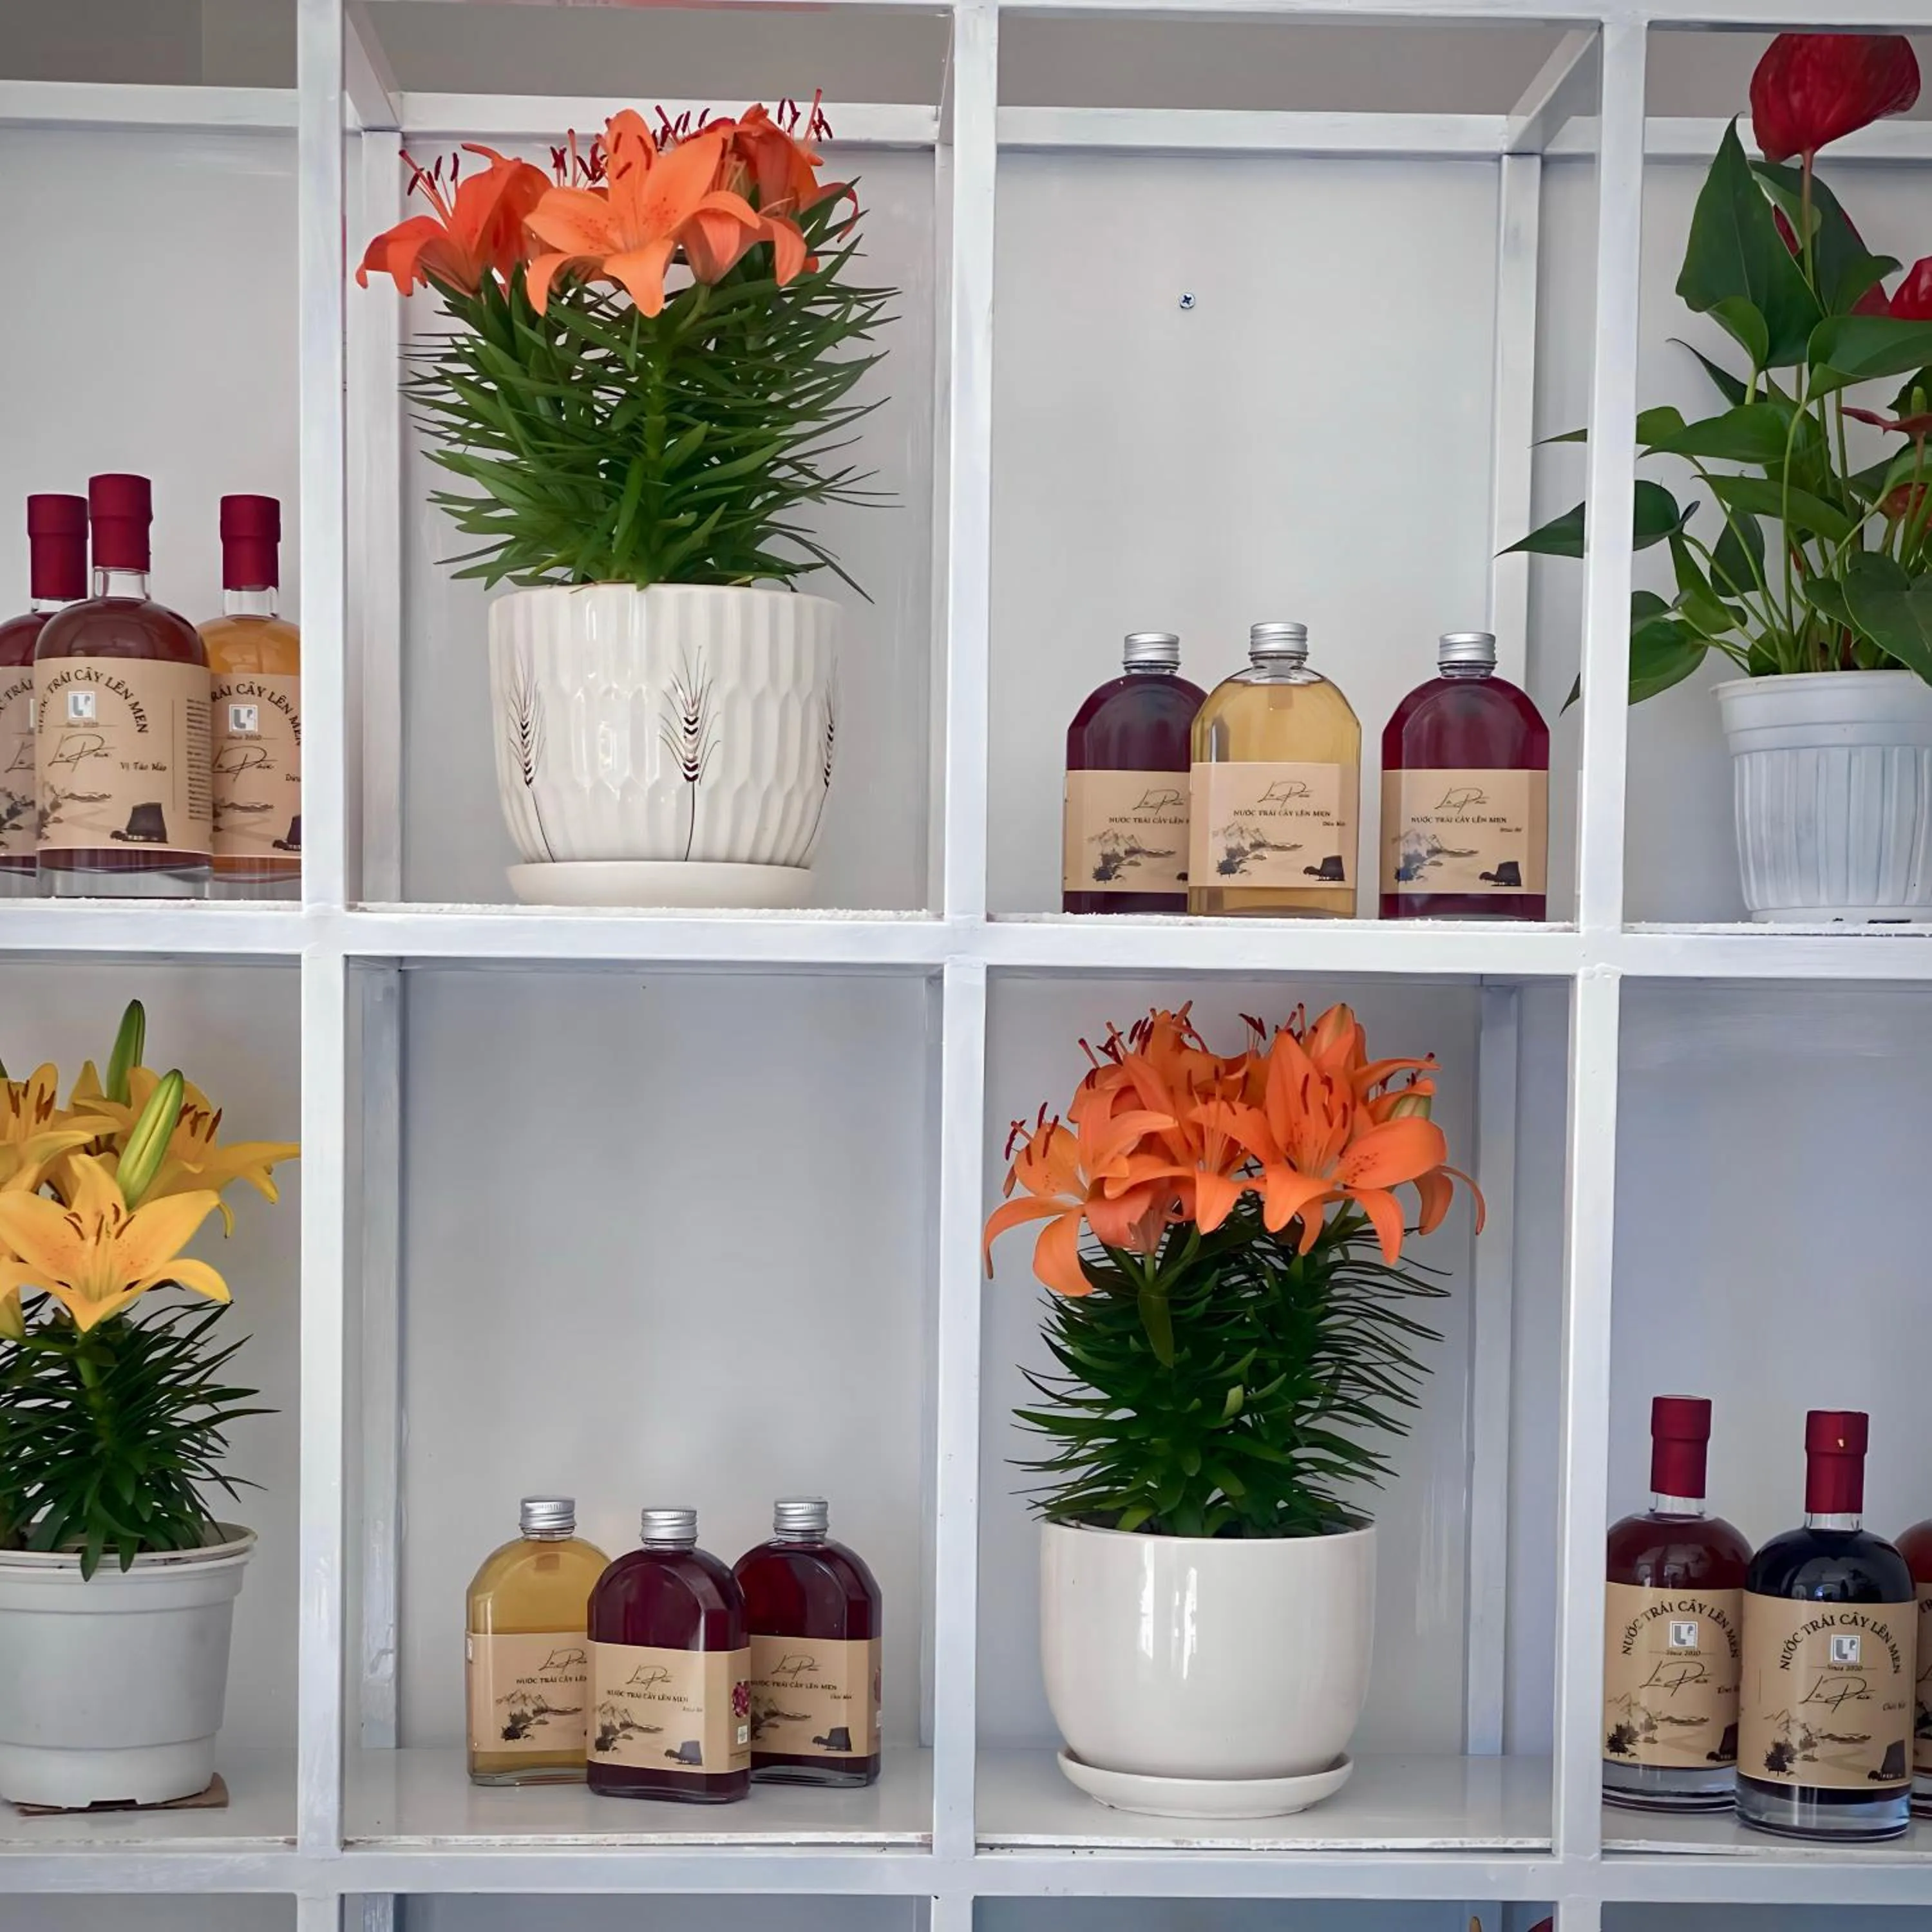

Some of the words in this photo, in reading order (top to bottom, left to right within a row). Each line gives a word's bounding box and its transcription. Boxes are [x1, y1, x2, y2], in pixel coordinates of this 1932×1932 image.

[47, 670, 72, 694] TRÁI
[74, 667, 104, 683] CÂY
[104, 676, 134, 701] LÊN
[128, 700, 149, 734] MEN
[211, 685, 232, 703] RÁI
[236, 681, 267, 697] CÂY
[267, 691, 292, 715] LÊN
[1622, 1618, 1644, 1656] NƯỚC
[1641, 1601, 1674, 1623] TRÁI
[1678, 1599, 1707, 1615] CÂY
[1708, 1607, 1730, 1630] LÊN
[1726, 1629, 1740, 1659] MEN
[1779, 1632, 1804, 1671] NƯỚC
[1801, 1614, 1836, 1636] TRÁI
[1839, 1611, 1870, 1629] CÂY
[1870, 1621, 1893, 1644] LÊN
[1888, 1642, 1902, 1674] MEN
